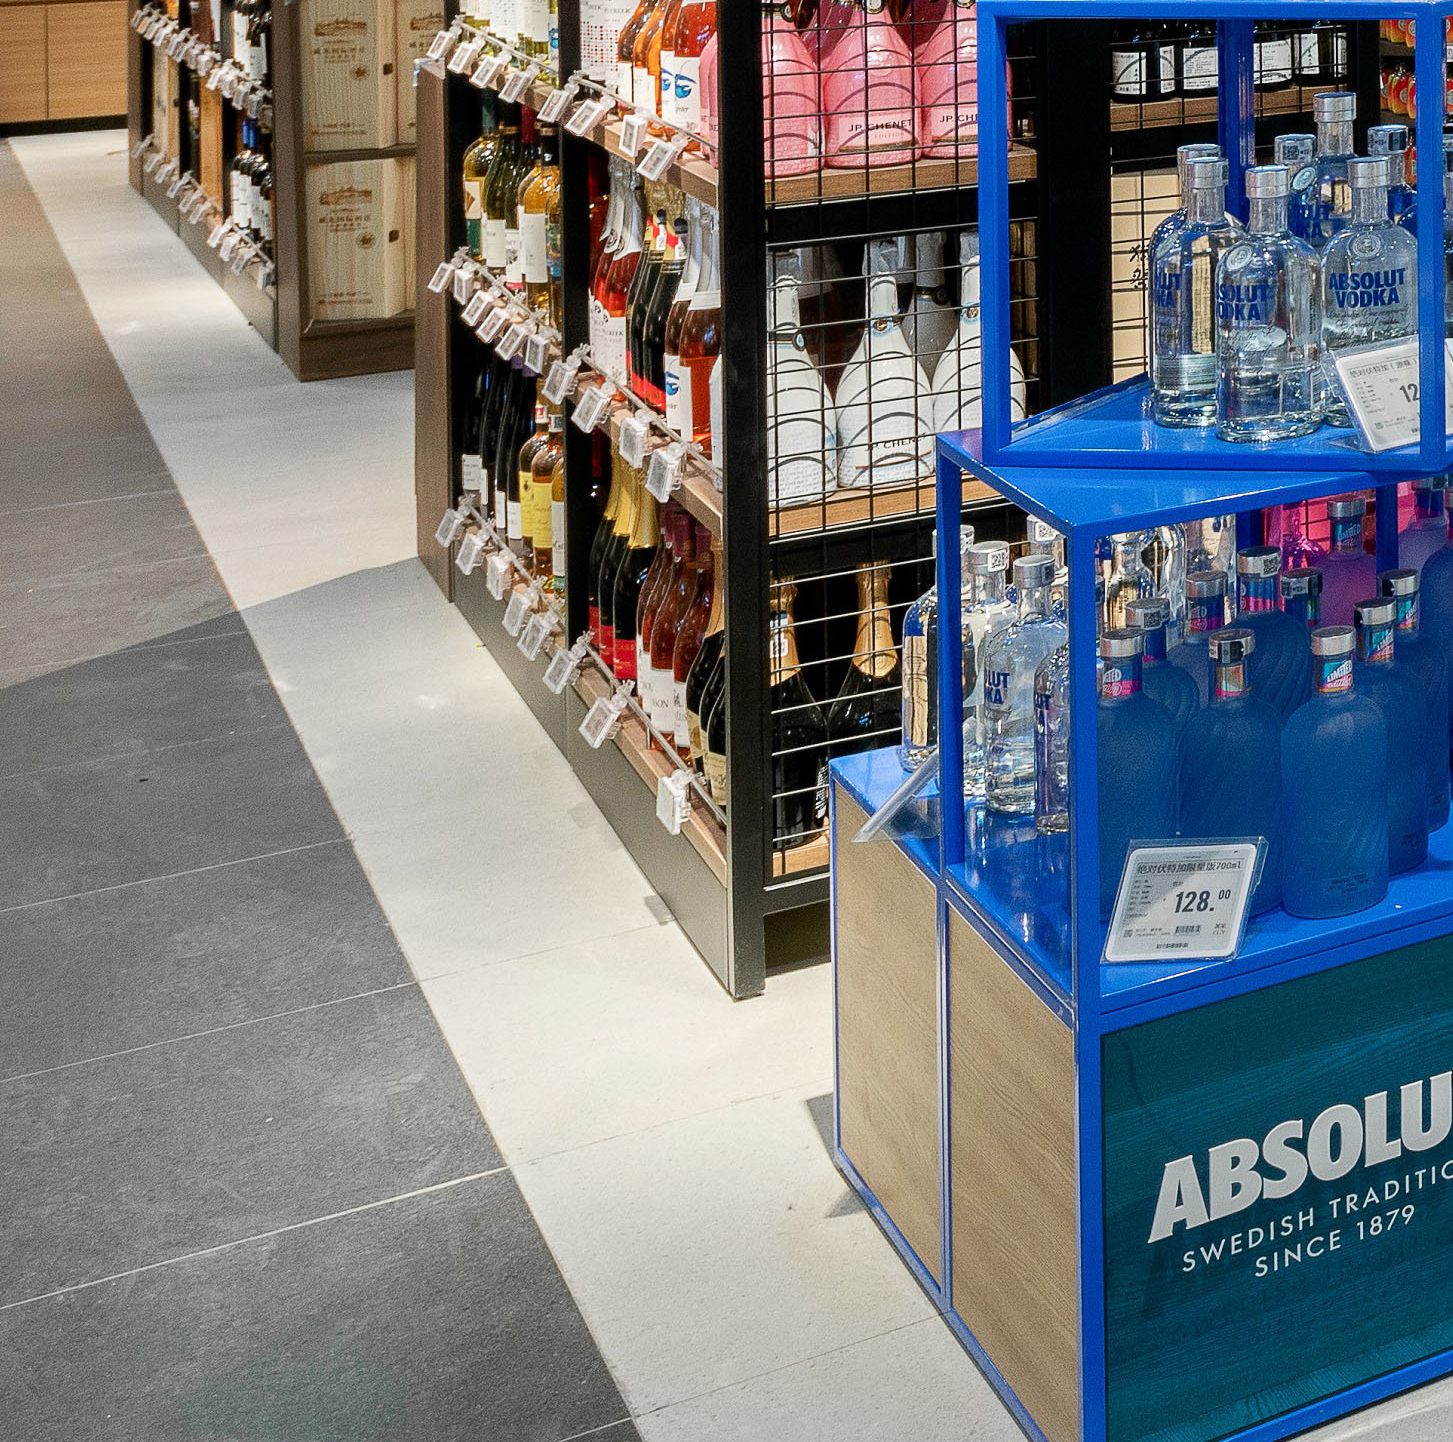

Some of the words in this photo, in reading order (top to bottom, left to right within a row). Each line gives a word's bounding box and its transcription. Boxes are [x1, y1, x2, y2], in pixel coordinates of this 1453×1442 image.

[1329, 267, 1406, 291] ABSOLUT
[1335, 287, 1401, 310] VODKA
[1182, 1212, 1315, 1273] SWEDISH
[1254, 1229, 1342, 1278] SINCE
[1356, 1203, 1416, 1241] 1879
